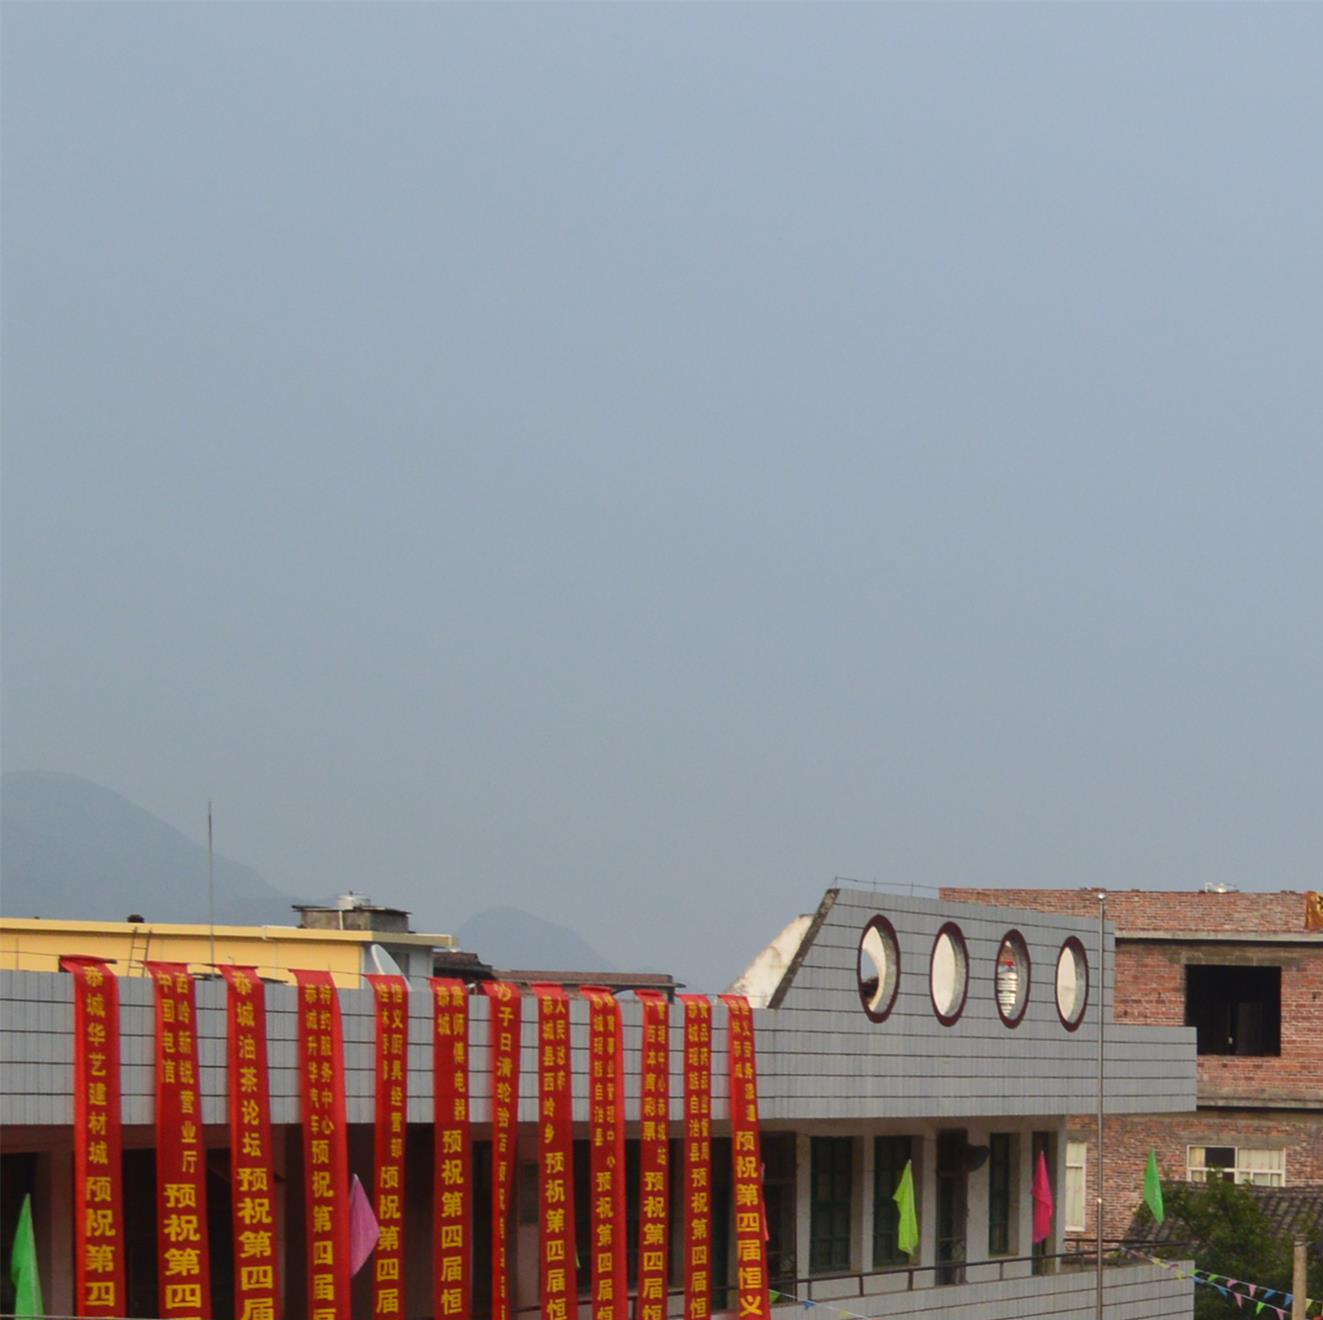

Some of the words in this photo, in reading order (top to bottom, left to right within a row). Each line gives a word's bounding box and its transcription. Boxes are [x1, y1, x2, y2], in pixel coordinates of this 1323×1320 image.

[156, 974, 176, 1085] 中国电信
[232, 972, 263, 1157] 恭城油茶论坛
